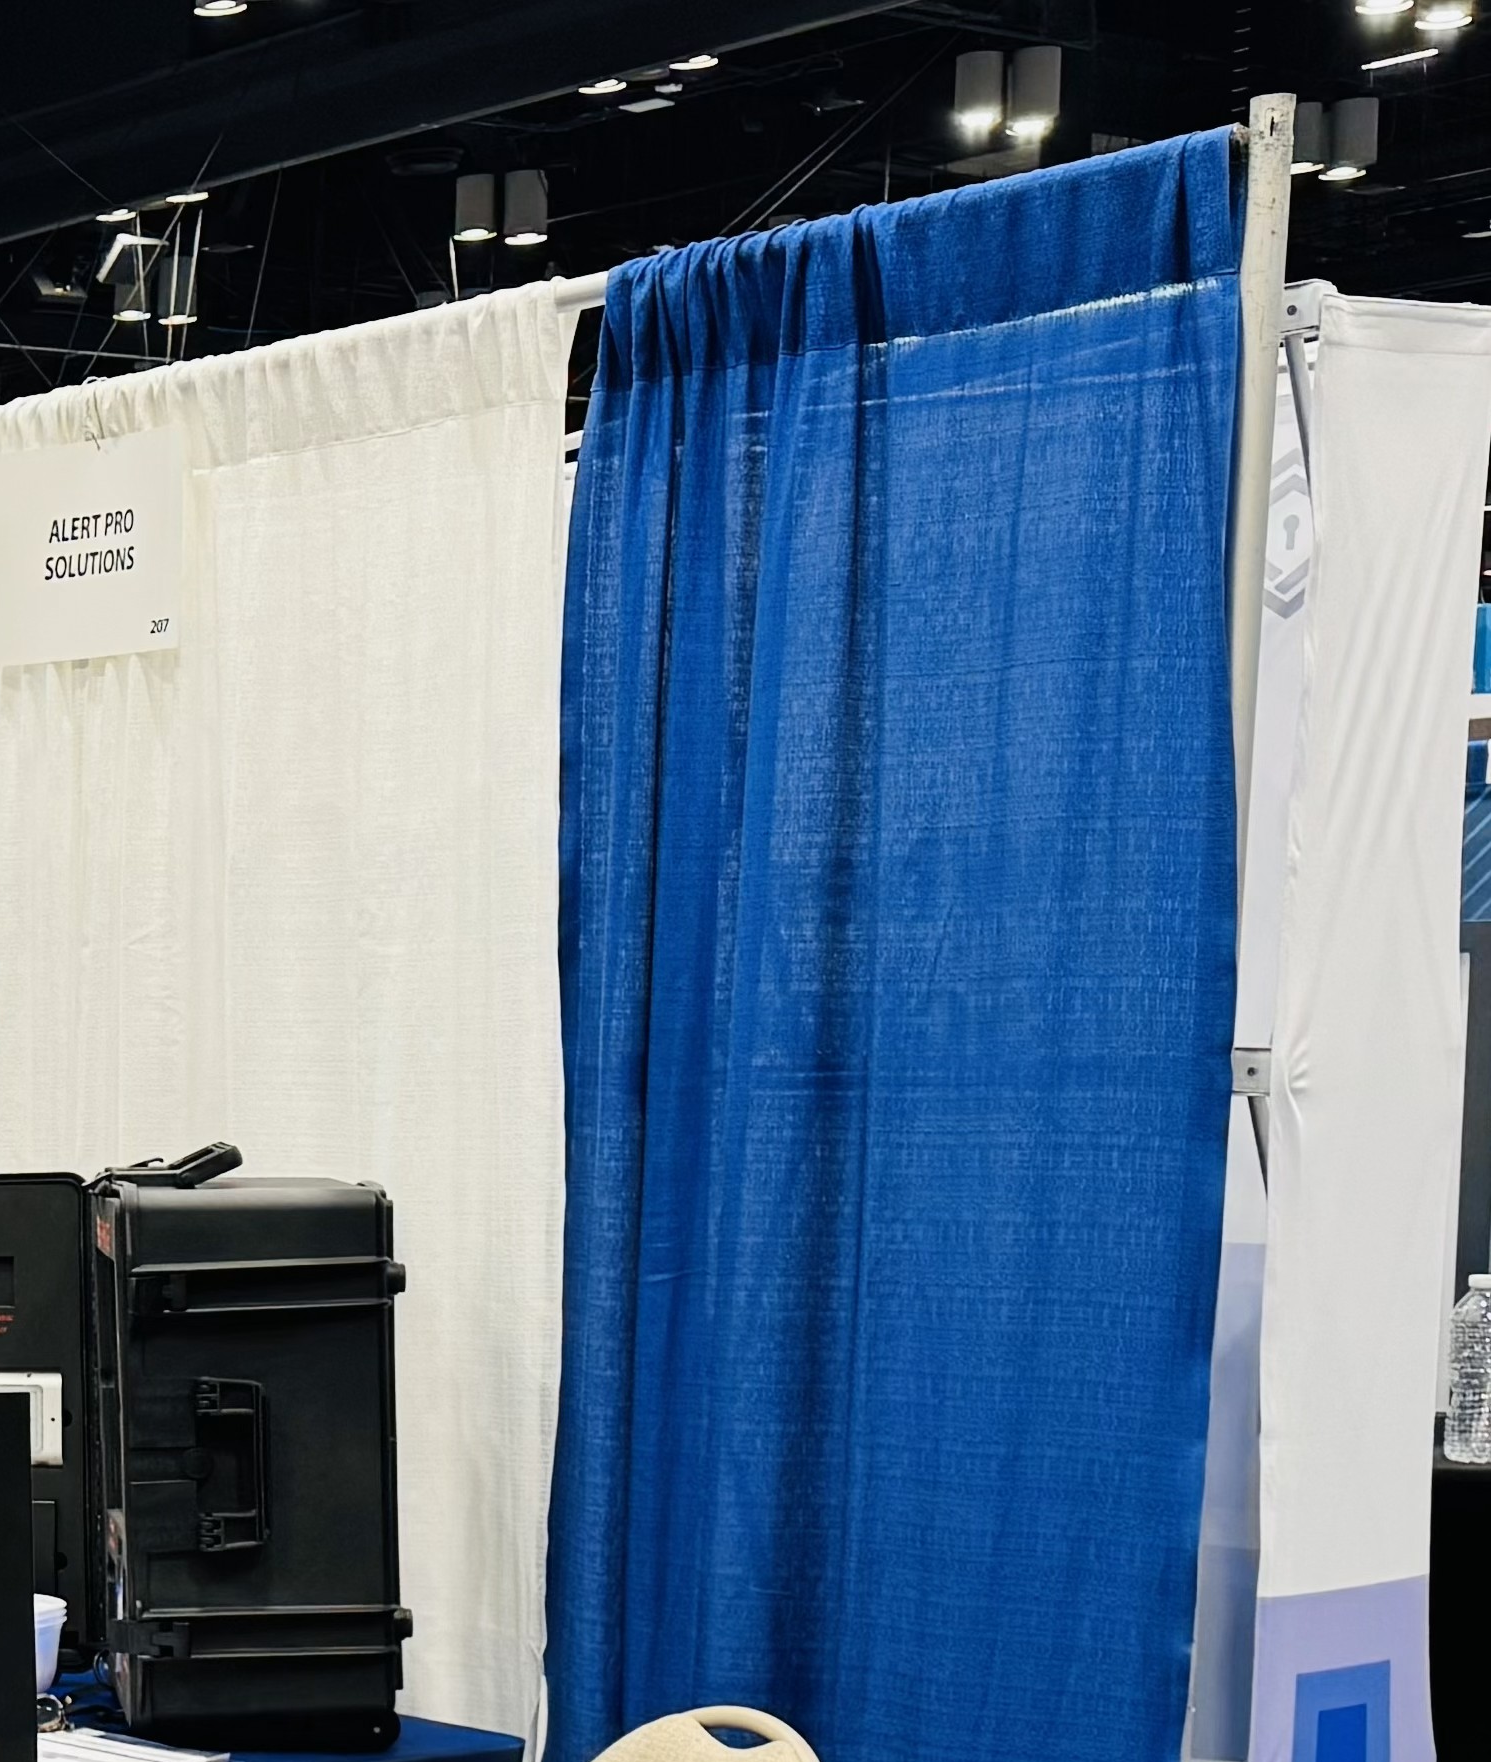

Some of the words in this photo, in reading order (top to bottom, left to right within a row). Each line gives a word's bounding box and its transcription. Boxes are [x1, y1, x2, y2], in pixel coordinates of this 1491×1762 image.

[48, 514, 102, 544] ALERT
[104, 508, 135, 537] PRO
[44, 546, 135, 581] SOLUTIONS
[149, 618, 170, 635] 207
